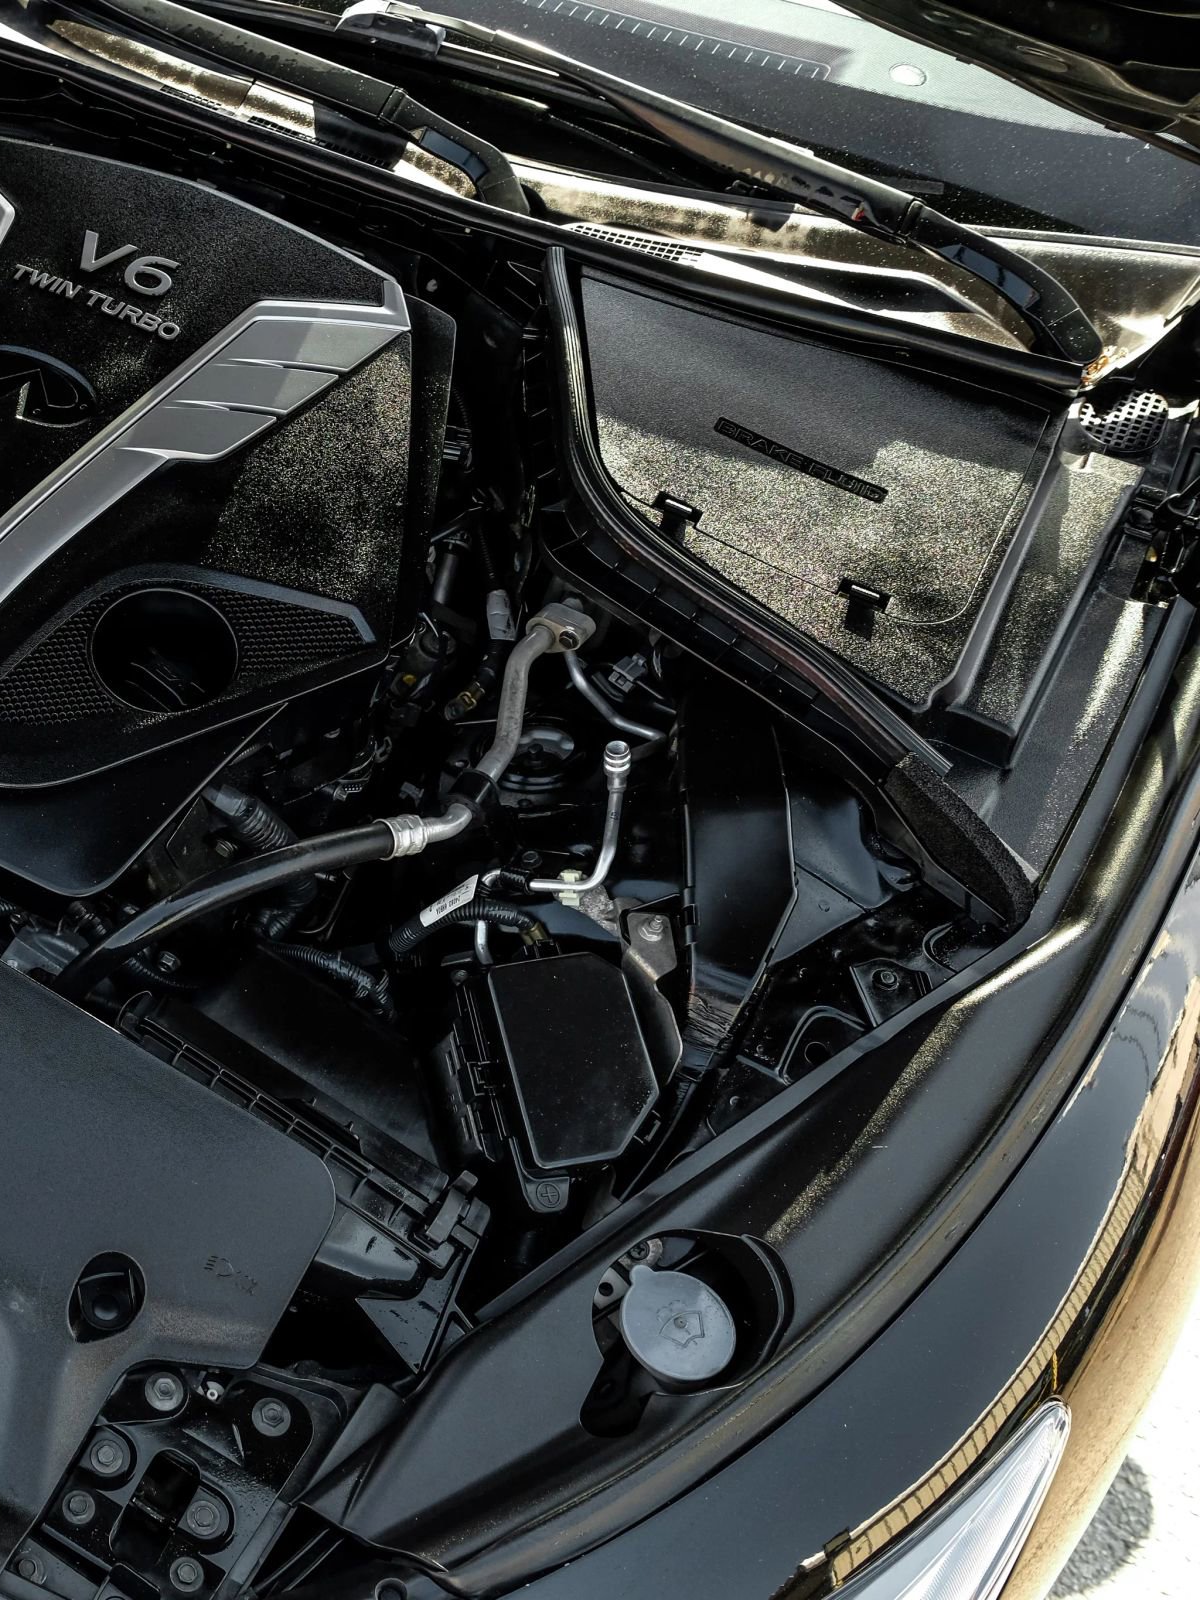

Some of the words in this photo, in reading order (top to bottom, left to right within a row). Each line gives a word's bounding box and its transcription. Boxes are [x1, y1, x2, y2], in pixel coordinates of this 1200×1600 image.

[80, 229, 181, 296] V6
[12, 263, 83, 299] TWIN
[86, 289, 181, 341] TURBO
[717, 420, 804, 468] BRAKE
[809, 462, 887, 502] FLUID
